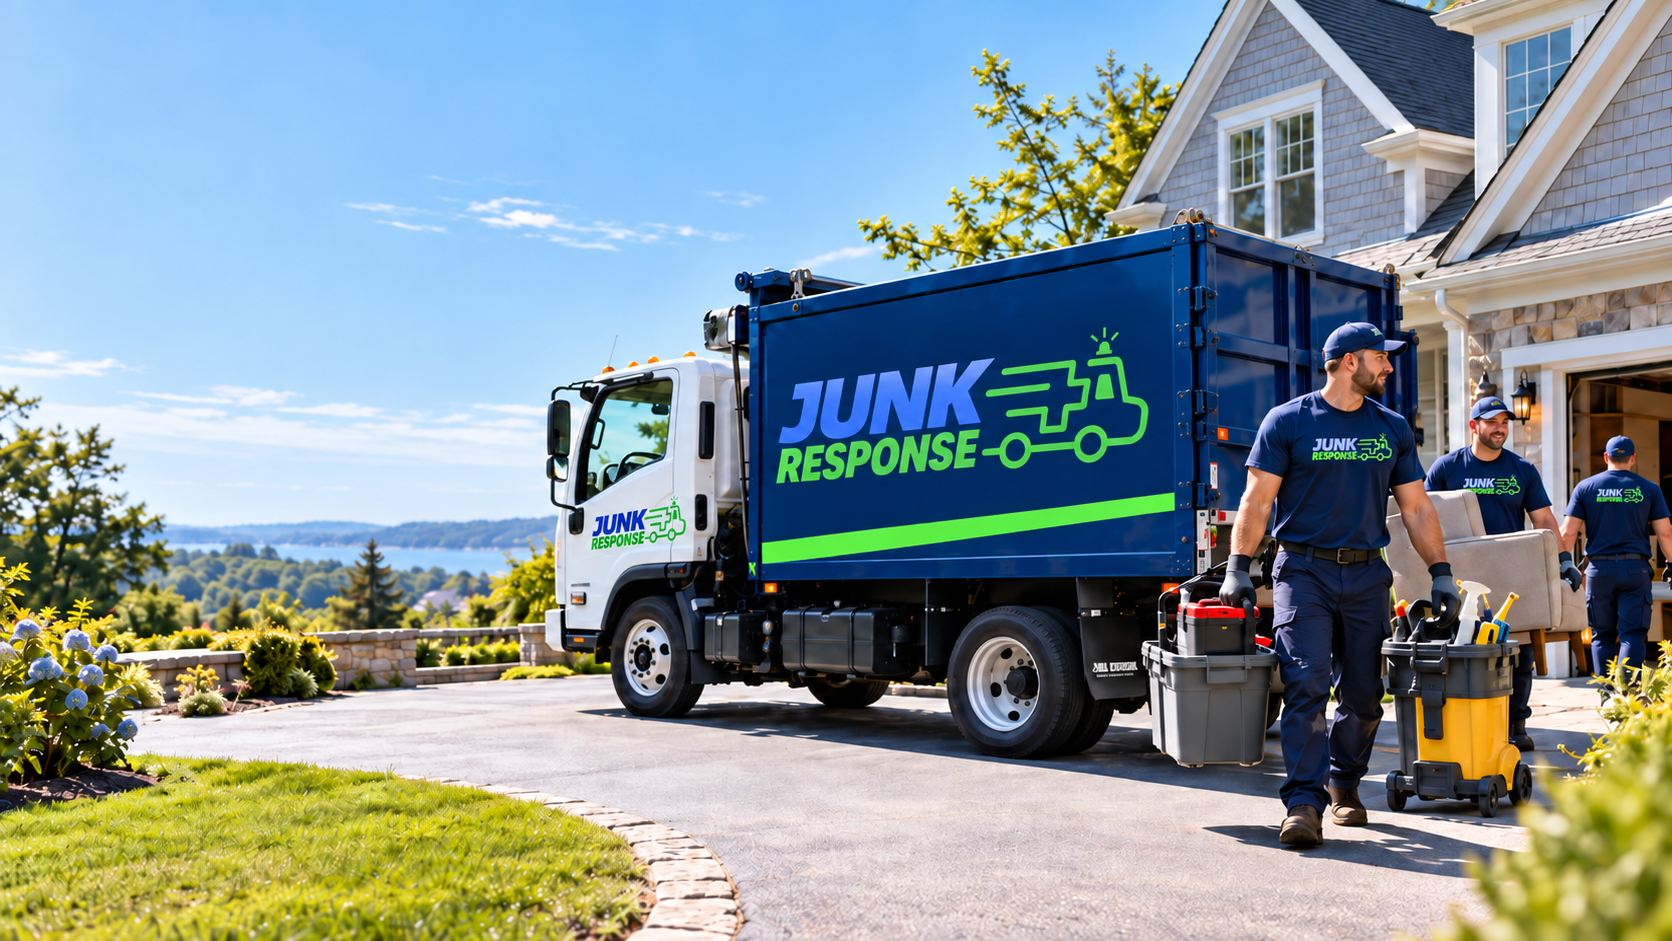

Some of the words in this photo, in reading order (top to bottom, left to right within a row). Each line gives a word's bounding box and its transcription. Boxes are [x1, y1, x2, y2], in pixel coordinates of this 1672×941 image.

[778, 358, 995, 444] JUNK
[1312, 437, 1358, 451] JUNK
[776, 429, 980, 484] RESPONSE
[1312, 450, 1358, 461] RESPONSE
[1463, 478, 1495, 488] JUNK
[1596, 488, 1623, 497] JUNK
[592, 508, 648, 537] JUNK
[591, 531, 645, 550] RESPONSE
